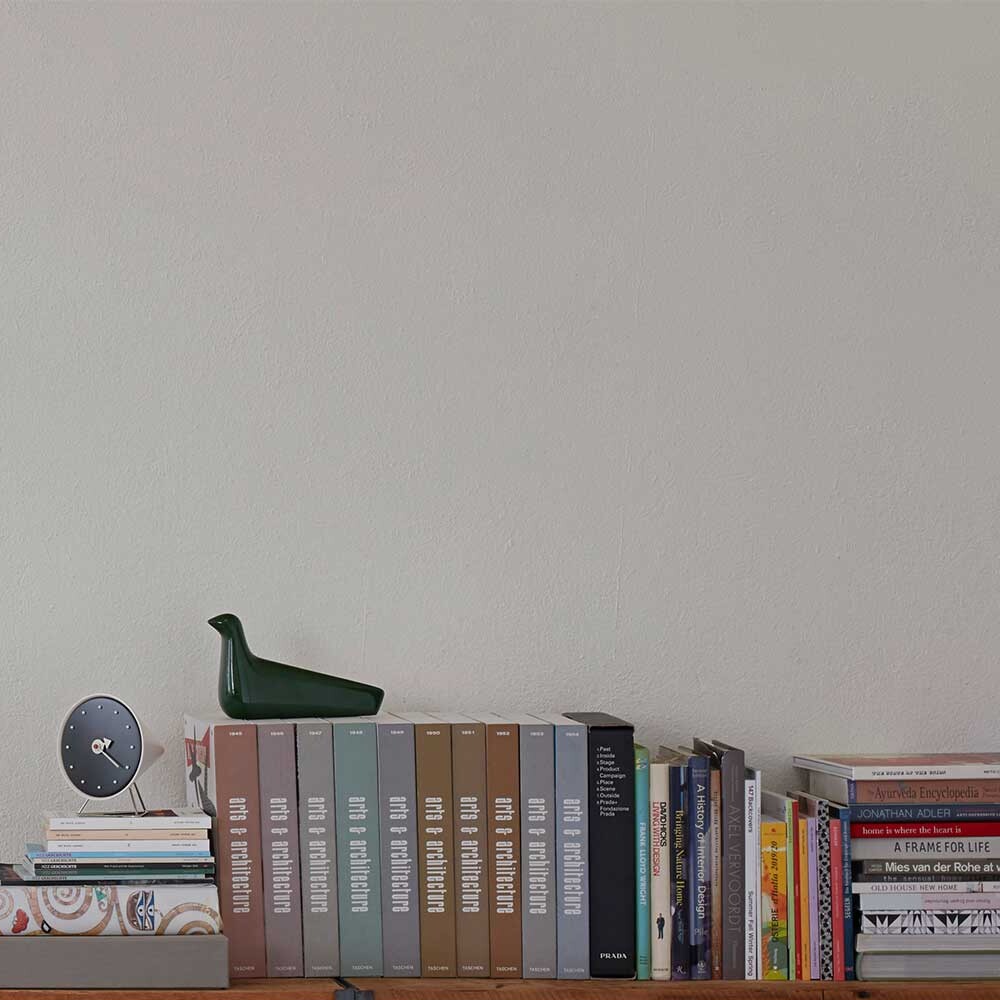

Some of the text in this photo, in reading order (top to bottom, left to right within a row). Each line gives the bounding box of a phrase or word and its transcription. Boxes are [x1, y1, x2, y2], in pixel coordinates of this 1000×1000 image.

[875, 786, 979, 801] Ayurveda Encyclopedia
[229, 798, 248, 820] arts
[349, 797, 368, 819] arts
[425, 797, 445, 820] arts
[495, 798, 515, 821] arts
[857, 809, 912, 818] JONATHAN
[917, 809, 951, 817] ADLER
[863, 827, 884, 835] home
[919, 826, 931, 834] the
[674, 810, 686, 906] Bringing Nature Home
[694, 784, 707, 919] A History of Interior Design
[894, 842, 990, 852] A FRAME FOR LIFE
[231, 841, 252, 913] architecture
[350, 840, 371, 912] architecture
[426, 841, 447, 913] architecture
[496, 842, 517, 913] architecture
[728, 805, 741, 933] AXEL VERVOORDT
[885, 862, 993, 872] Mies van der Rohe at
